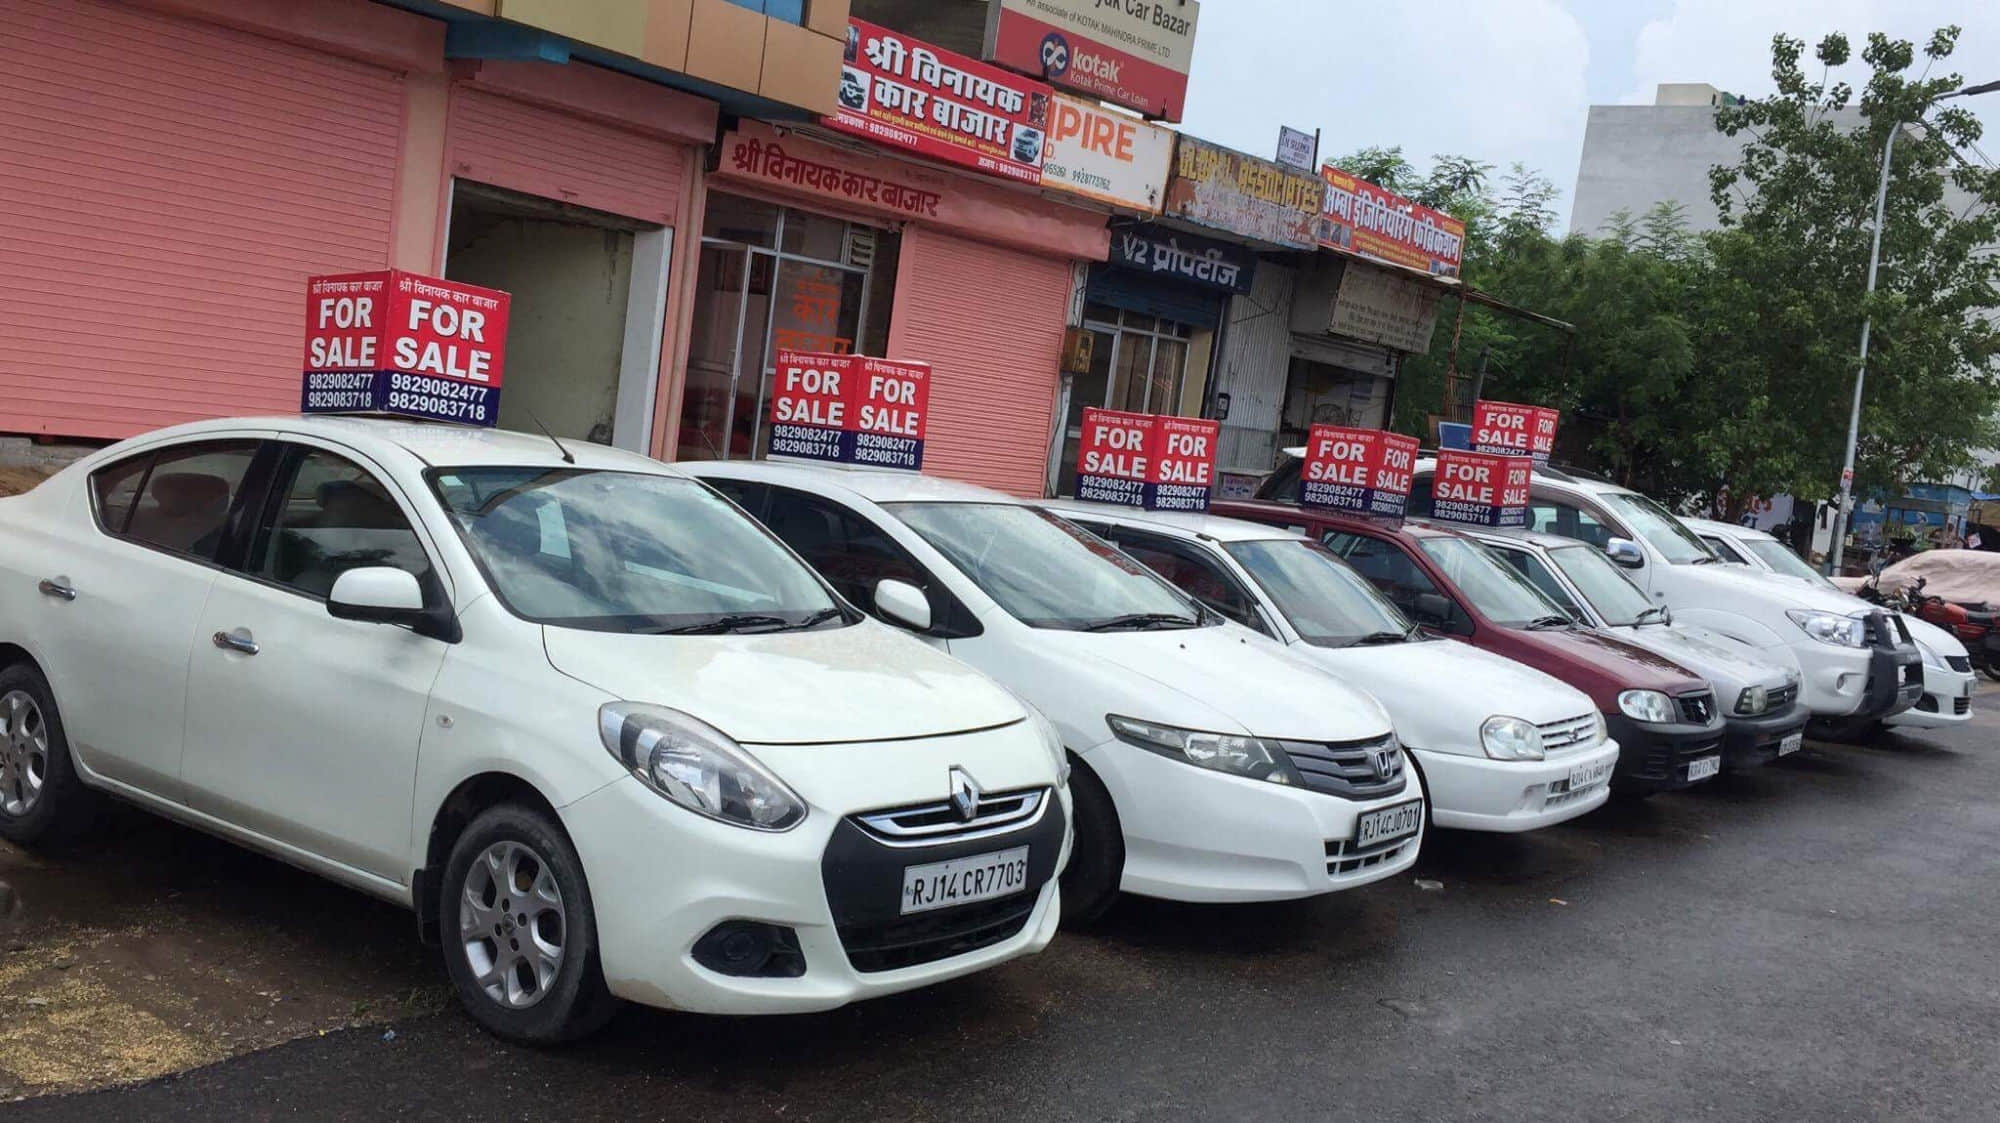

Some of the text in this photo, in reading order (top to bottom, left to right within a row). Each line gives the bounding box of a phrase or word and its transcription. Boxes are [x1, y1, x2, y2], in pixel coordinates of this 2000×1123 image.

[1126, 0, 1150, 21] Car
[1152, 4, 1191, 36] Bazar
[1077, 14, 1100, 30] KOTAK
[1101, 23, 1137, 44] MAHINDRA
[1137, 38, 1157, 52] PRIME
[1158, 45, 1171, 58] LTD
[864, 36, 1025, 114] श्री विनायक
[1072, 46, 1120, 83] kotak
[1070, 69, 1149, 107] Kotak Prime Car Loan
[874, 76, 929, 120] कार
[932, 95, 1010, 145] बाजार
[1048, 101, 1136, 162] PIRE
[732, 138, 761, 173] श्री
[762, 143, 842, 192] विनायक
[842, 170, 883, 203] कार
[881, 181, 942, 217] बाजार
[1122, 233, 1149, 264] V2
[399, 278, 499, 310] श्री विनायक कार बाजार
[319, 297, 373, 329] FOR
[409, 298, 485, 343] FOR
[310, 336, 377, 368] SALE
[394, 337, 492, 382] SALE
[309, 373, 374, 390] 9829082477
[391, 373, 488, 403] 9829082477
[786, 367, 841, 396] FOR
[869, 376, 916, 405] FOR
[308, 391, 372, 408] 9829083718
[389, 391, 485, 420] 9829083718
[776, 397, 845, 426] SALE
[859, 405, 920, 435] SALE
[1485, 412, 1525, 430] FOR
[1538, 418, 1554, 434] FOR
[774, 425, 842, 443] 9829082477
[857, 433, 916, 451] 9829082477
[1094, 425, 1144, 451] FOR
[1167, 433, 1207, 457] FOR
[1477, 429, 1528, 448] SALE
[1533, 435, 1552, 452] SALE
[773, 438, 840, 457] 9829083718
[855, 447, 915, 465] 9829083718
[1318, 440, 1365, 462] FOR
[1383, 448, 1410, 470] FOR
[1084, 451, 1147, 479] SALE
[1158, 459, 1209, 483] SALE
[1308, 461, 1368, 485] SALE
[1445, 463, 1490, 483] FOR
[1508, 469, 1526, 485] FOR
[1082, 475, 1144, 493] 9829082477
[1157, 484, 1206, 498] 9829082477
[1306, 482, 1365, 498] 9829082477
[1375, 470, 1409, 492] SALE
[1436, 482, 1494, 504] SALE
[1080, 487, 1143, 505] 9829083718
[1155, 496, 1205, 510] 9829083718
[1304, 492, 1362, 509] 9829083718
[1434, 500, 1491, 514] 9829082477
[1502, 488, 1527, 505] SALE
[1433, 509, 1490, 524] 9829083718
[912, 860, 1026, 906] RJ14 CR7703
